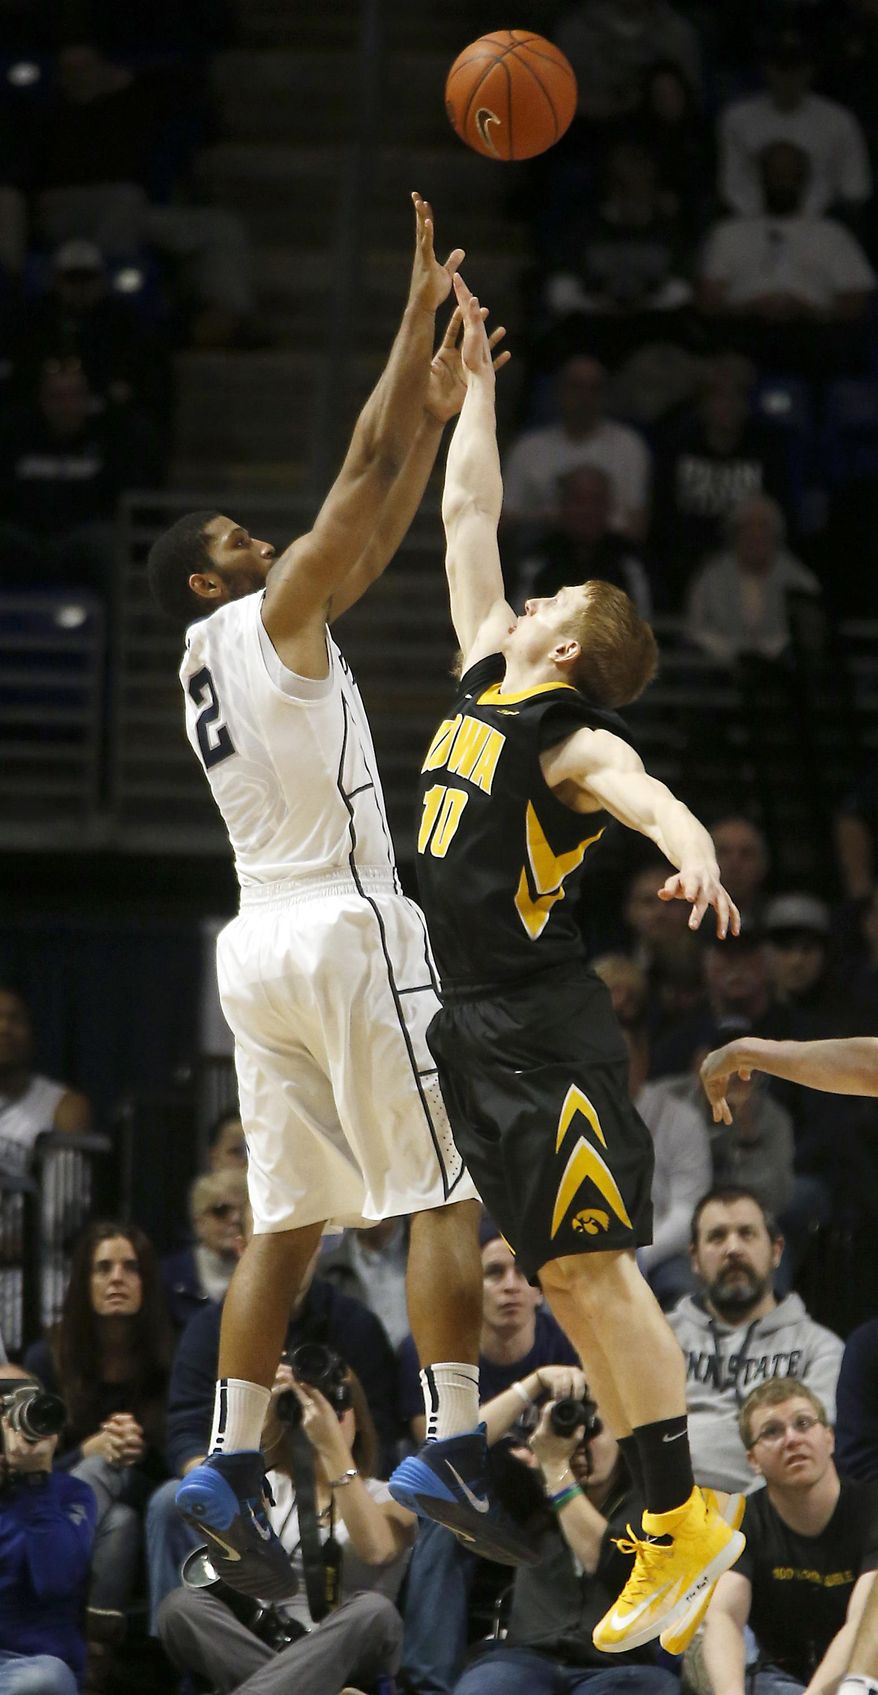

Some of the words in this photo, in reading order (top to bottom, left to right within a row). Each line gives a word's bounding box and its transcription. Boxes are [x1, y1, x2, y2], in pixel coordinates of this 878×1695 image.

[188, 665, 236, 769] 2
[417, 783, 469, 858] 10
[722, 1350, 801, 1391] STATE
